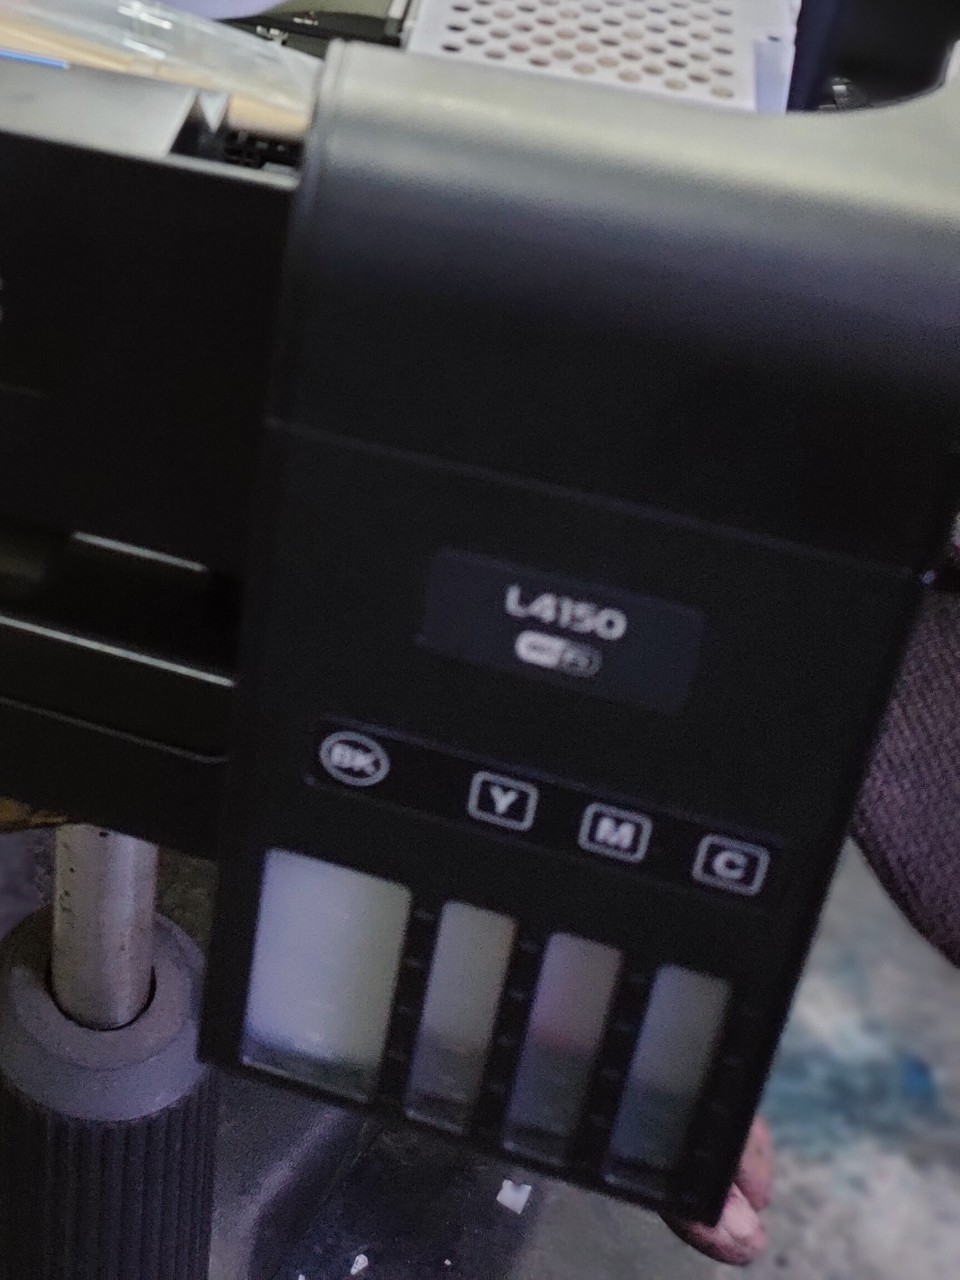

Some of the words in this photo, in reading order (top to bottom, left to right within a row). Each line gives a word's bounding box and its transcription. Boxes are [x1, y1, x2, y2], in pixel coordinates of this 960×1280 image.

[505, 584, 628, 640] L4150
[330, 742, 377, 775] BK
[489, 784, 520, 816] Y
[595, 816, 637, 851] M
[711, 849, 749, 881] C
